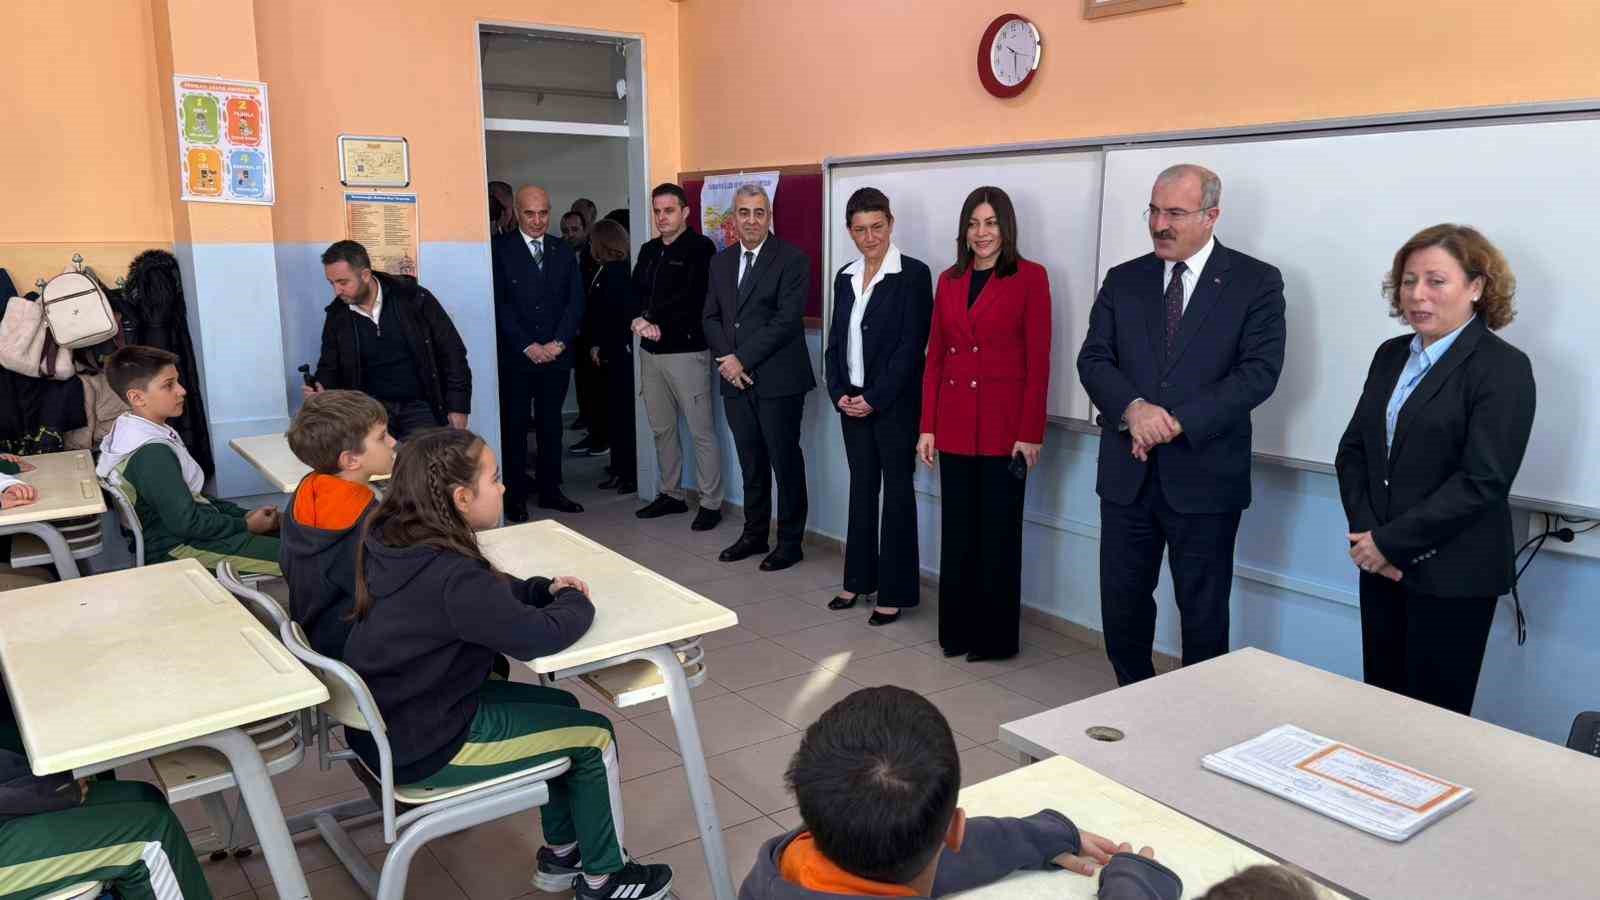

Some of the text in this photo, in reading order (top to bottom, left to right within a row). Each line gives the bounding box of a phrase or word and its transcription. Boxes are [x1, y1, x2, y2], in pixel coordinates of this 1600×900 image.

[196, 97, 203, 107] 1
[238, 100, 247, 110] 2
[198, 152, 208, 162] 3
[240, 154, 250, 164] 4
